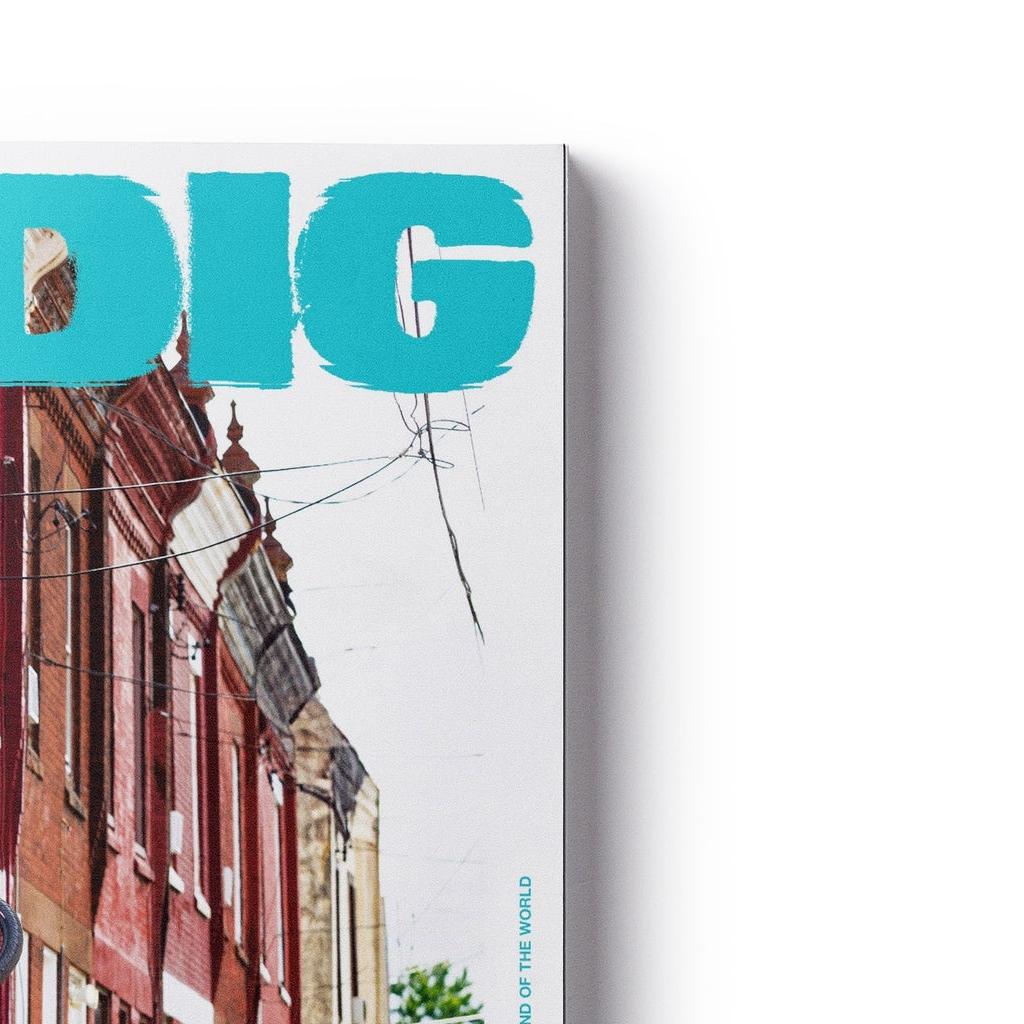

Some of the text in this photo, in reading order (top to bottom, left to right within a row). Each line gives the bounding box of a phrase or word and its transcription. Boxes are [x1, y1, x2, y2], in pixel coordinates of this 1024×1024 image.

[518, 875, 533, 936] WORLD
[518, 942, 533, 971] THE
[518, 977, 533, 999] OF
